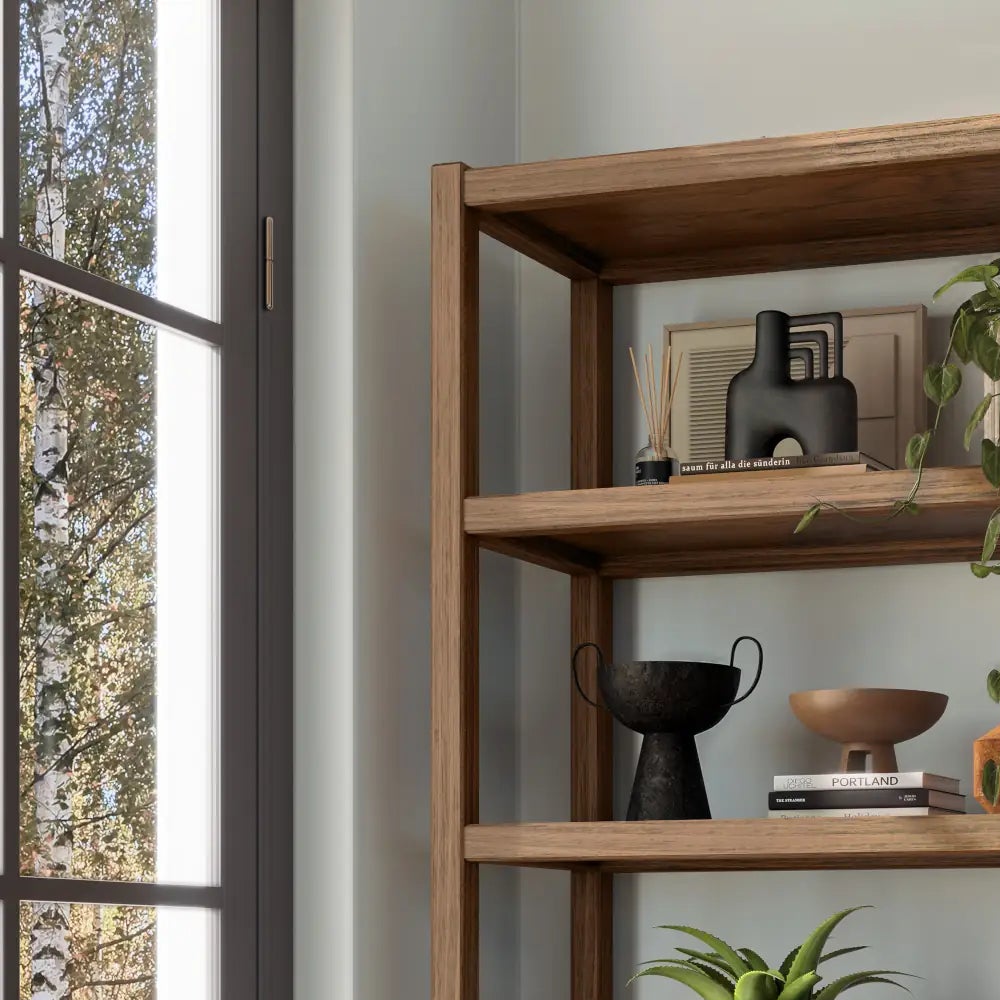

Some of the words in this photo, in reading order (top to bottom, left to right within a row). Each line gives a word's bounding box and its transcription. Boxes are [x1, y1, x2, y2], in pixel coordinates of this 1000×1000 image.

[682, 464, 703, 472] saum
[706, 462, 718, 471] für
[720, 460, 736, 470] alla
[738, 459, 751, 469] die
[753, 457, 791, 468] sünderin
[832, 776, 899, 787] PORTLAND
